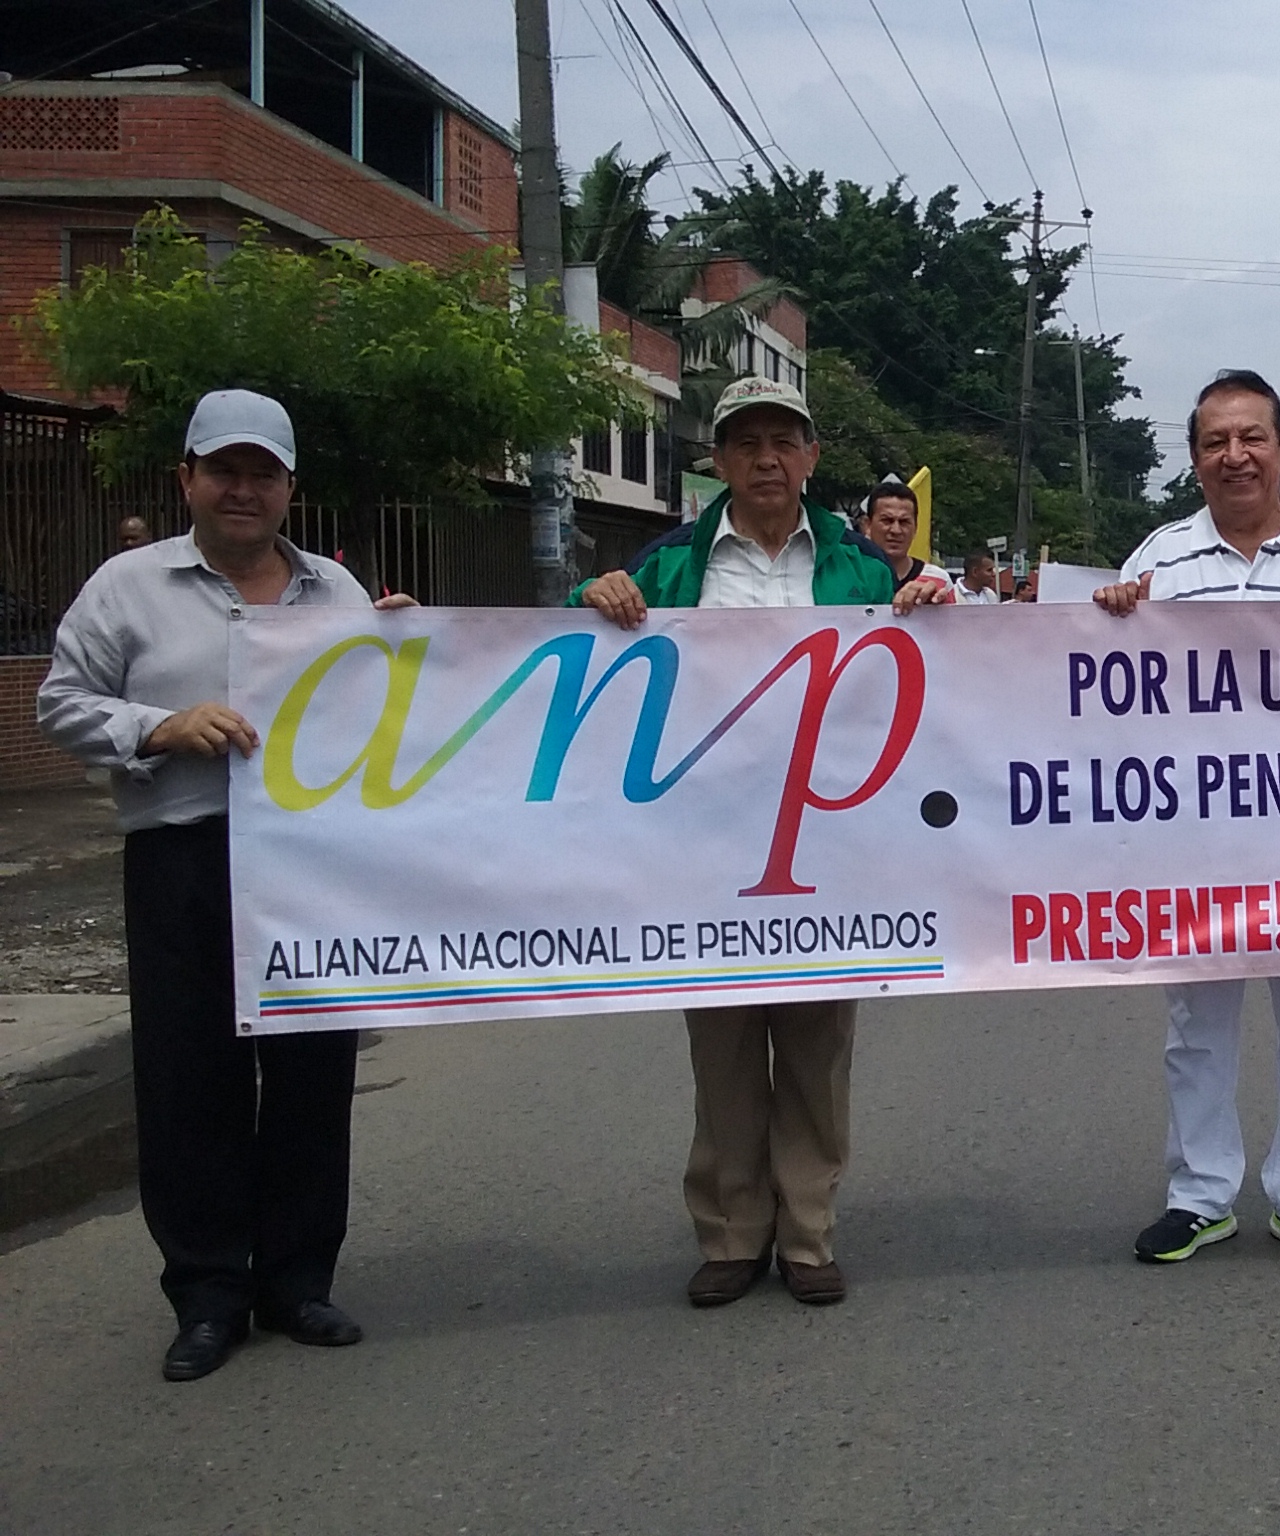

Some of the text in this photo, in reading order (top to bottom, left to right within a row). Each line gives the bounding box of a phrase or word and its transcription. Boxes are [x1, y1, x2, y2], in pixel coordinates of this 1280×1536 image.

[1069, 650, 1171, 717] POR
[1188, 649, 1243, 714] LA
[1010, 760, 1071, 826] DE
[1091, 756, 1179, 823] LOS
[265, 910, 938, 982] ALIANZA NACIONAL DE PENSIONADOS
